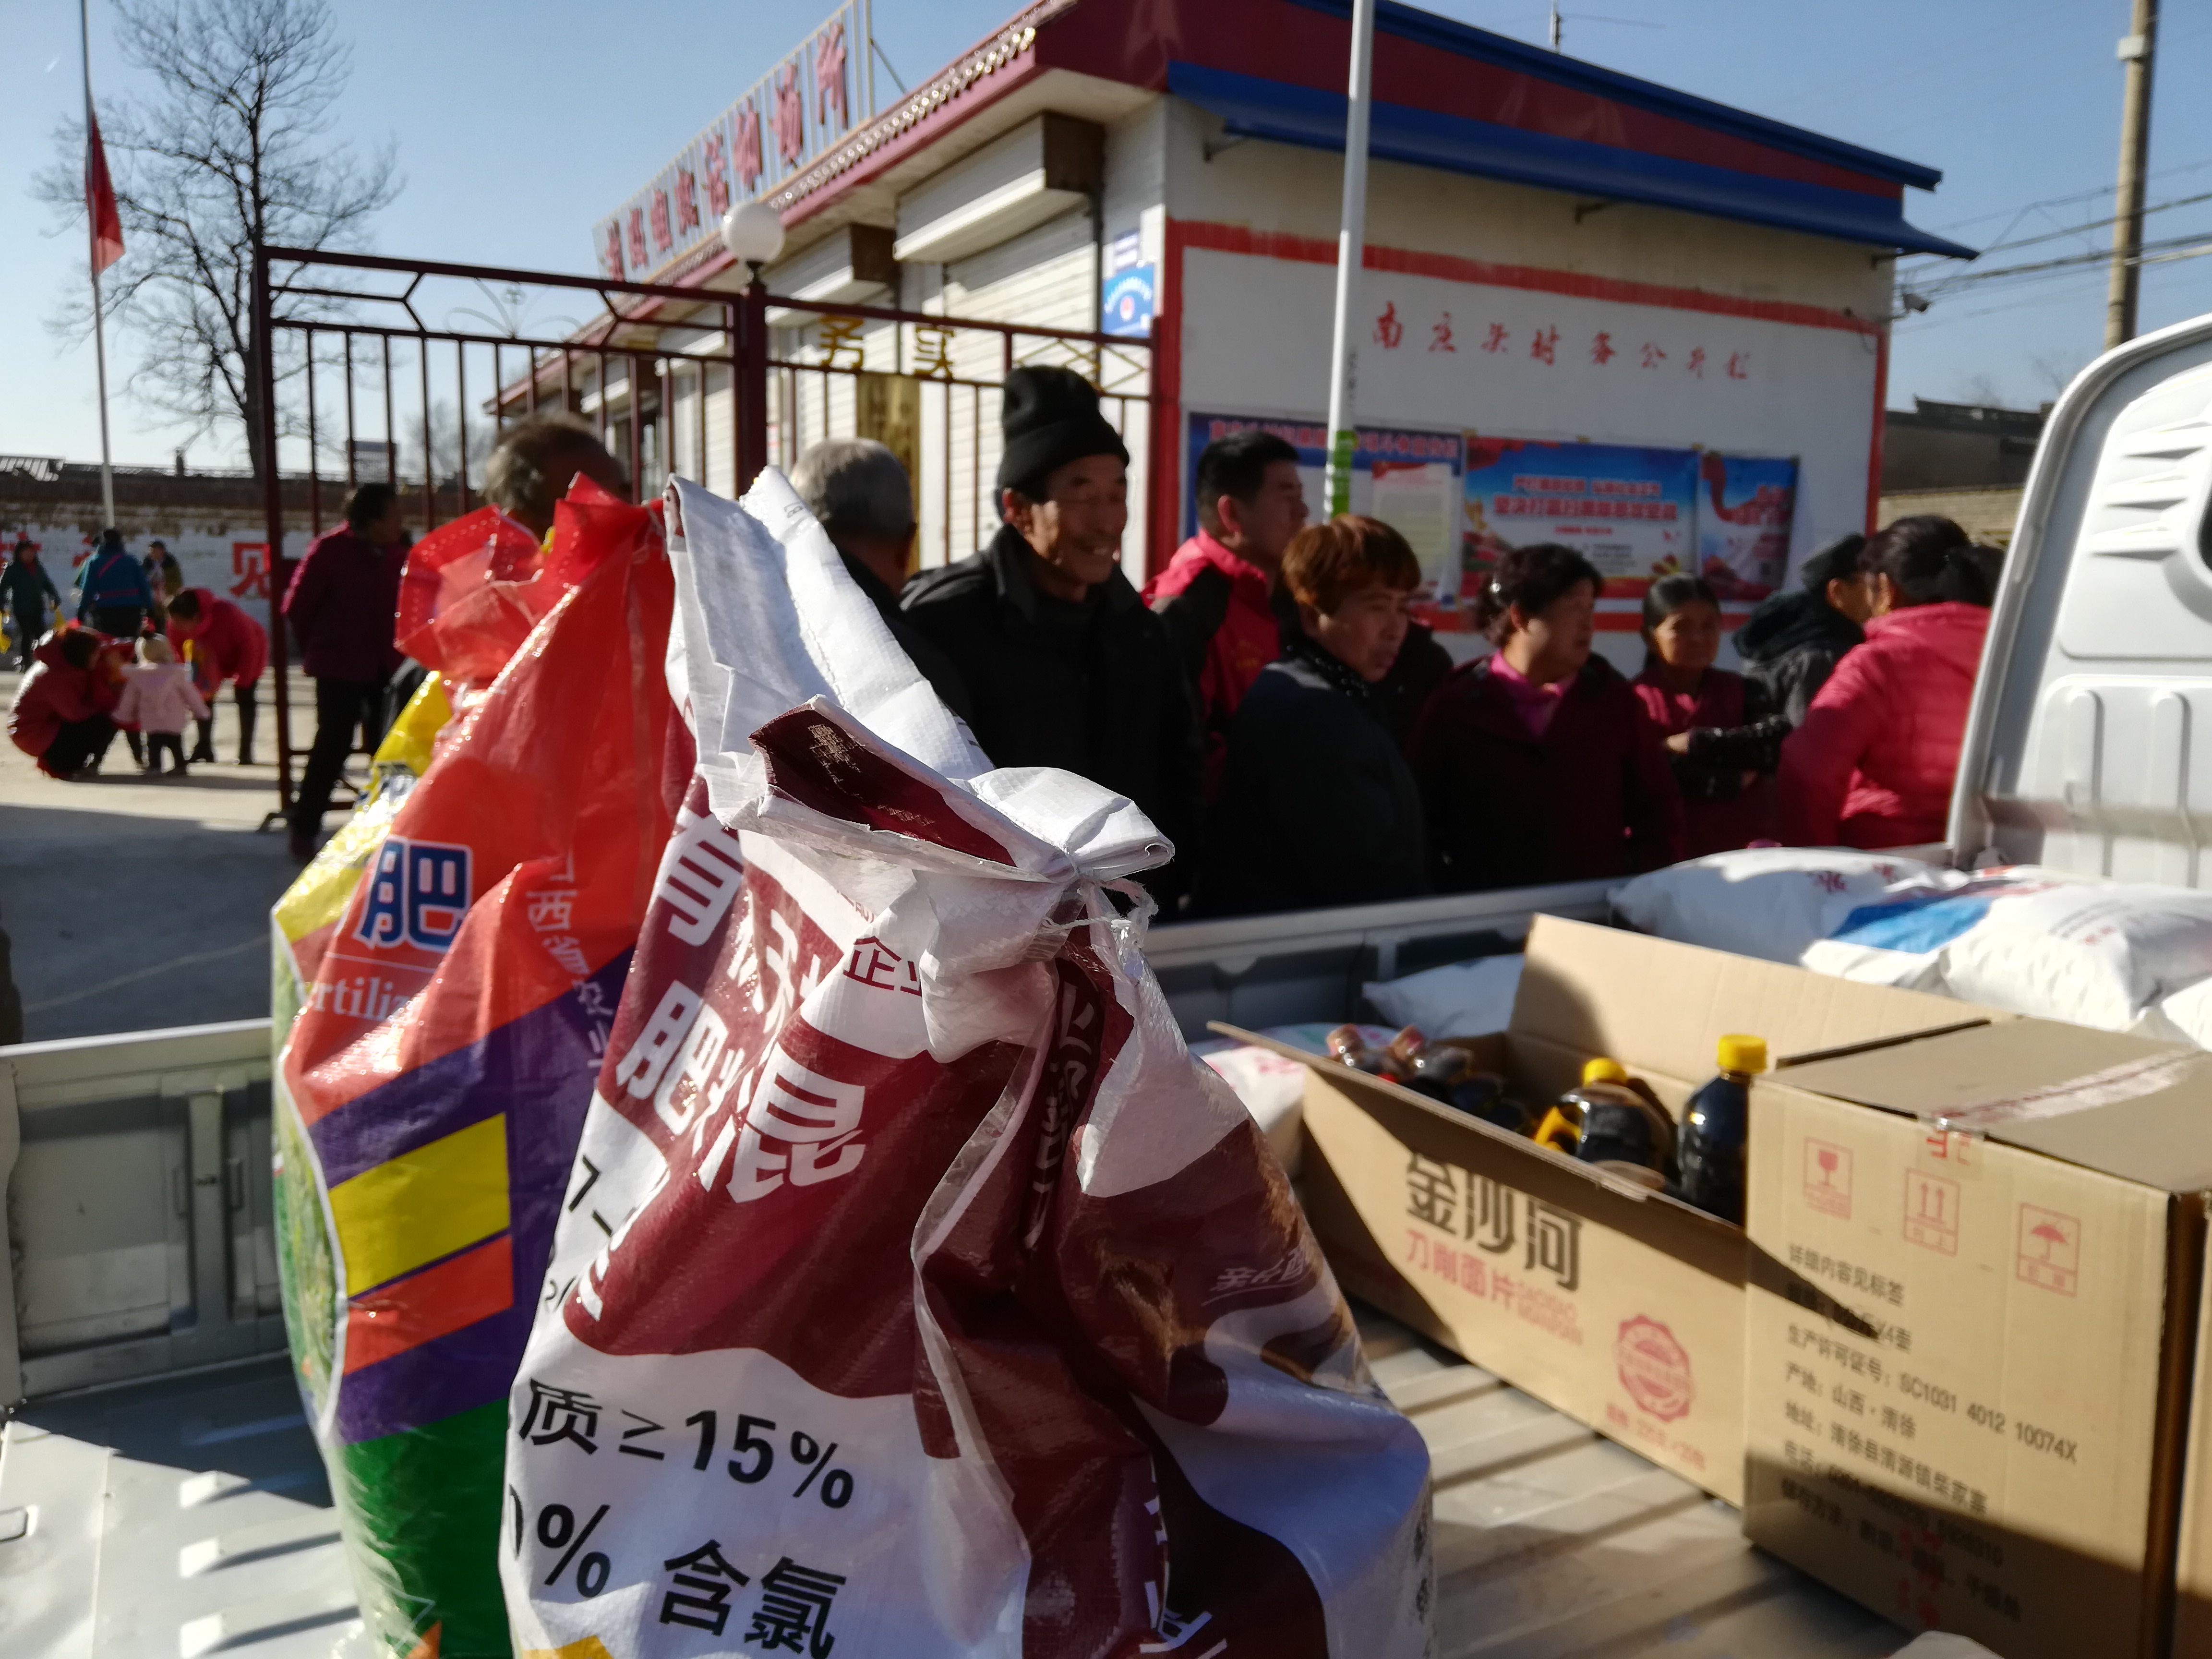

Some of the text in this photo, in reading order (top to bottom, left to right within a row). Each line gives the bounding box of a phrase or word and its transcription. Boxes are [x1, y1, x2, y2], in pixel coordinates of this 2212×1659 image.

[353, 835, 473, 954] 肥
[1789, 1244, 1905, 1306] 详细内容见标签
[1967, 1402, 2006, 1434] 4012
[2016, 1421, 2077, 1463] 10074X
[659, 1540, 847, 1659] 含氯
